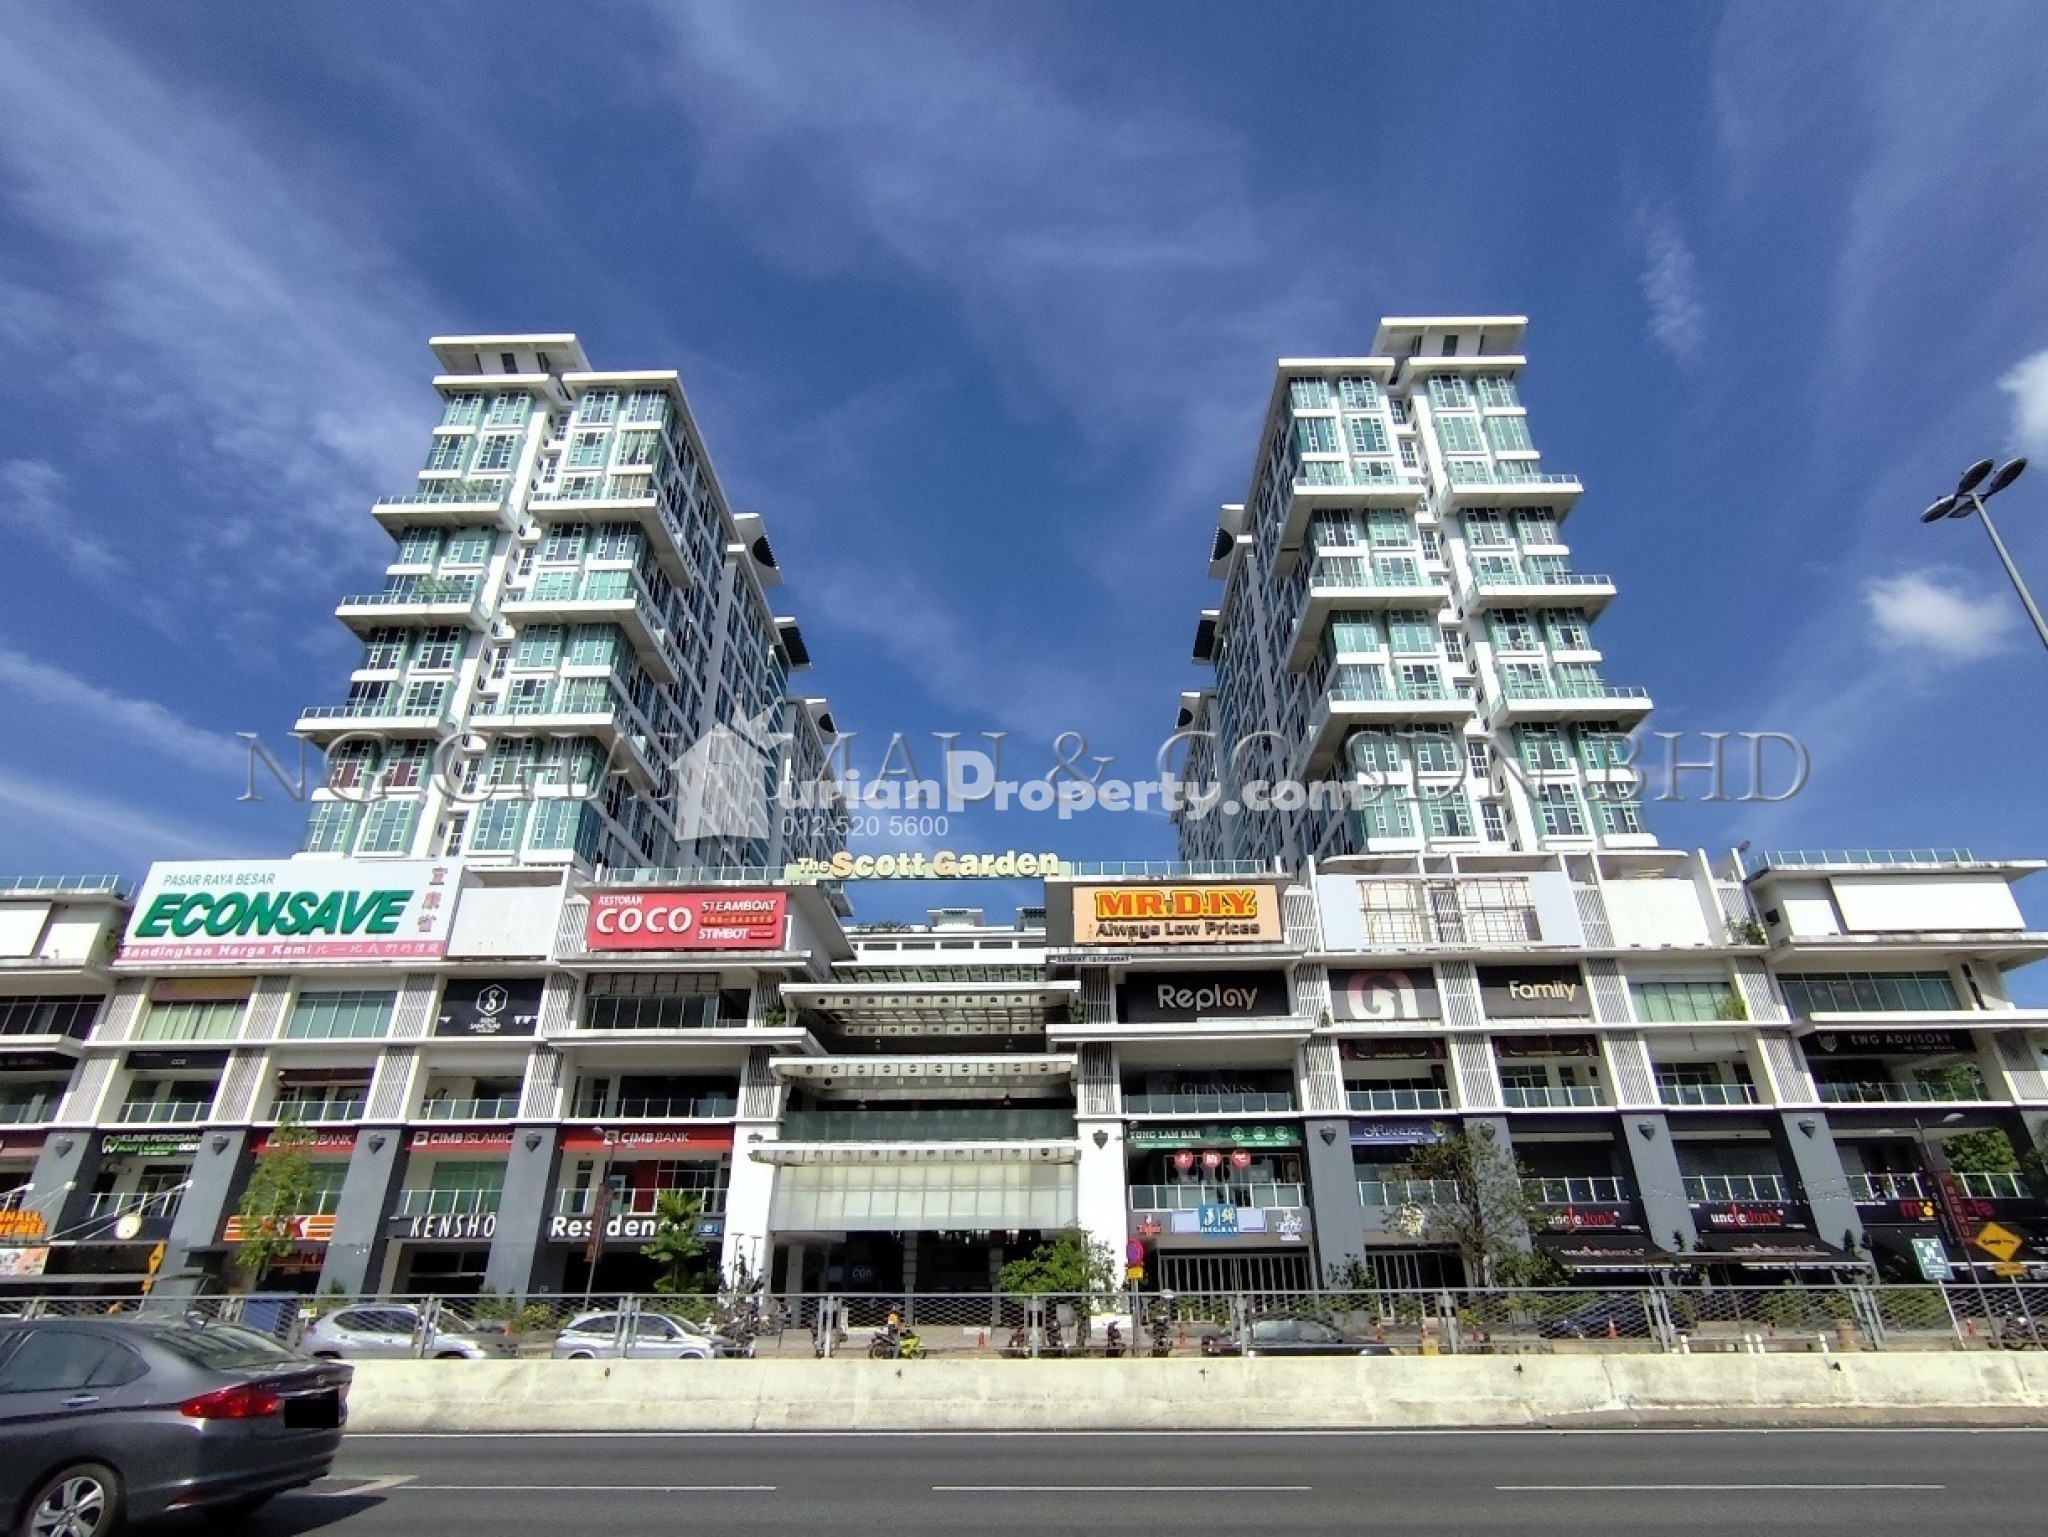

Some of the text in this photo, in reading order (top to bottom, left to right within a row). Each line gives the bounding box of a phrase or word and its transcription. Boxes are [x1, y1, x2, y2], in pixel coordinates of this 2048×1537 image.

[798, 850, 1060, 878] The Scott Garden
[163, 873, 275, 886] PASAR RAYA BESAR
[134, 889, 414, 938] ECONSAVE
[701, 900, 777, 912] STEAMBOAT
[595, 907, 692, 934] COCO
[1096, 921, 1261, 938] Always Low Prices
[218, 945, 266, 958] Harga
[272, 943, 313, 956] Kami
[1157, 983, 1258, 1011] Replay
[1508, 980, 1577, 1002] Family
[430, 1132, 514, 1144] CIMB ISLAMIC
[621, 1132, 690, 1143] CIMB BANK
[409, 1214, 497, 1238] KENSHO
